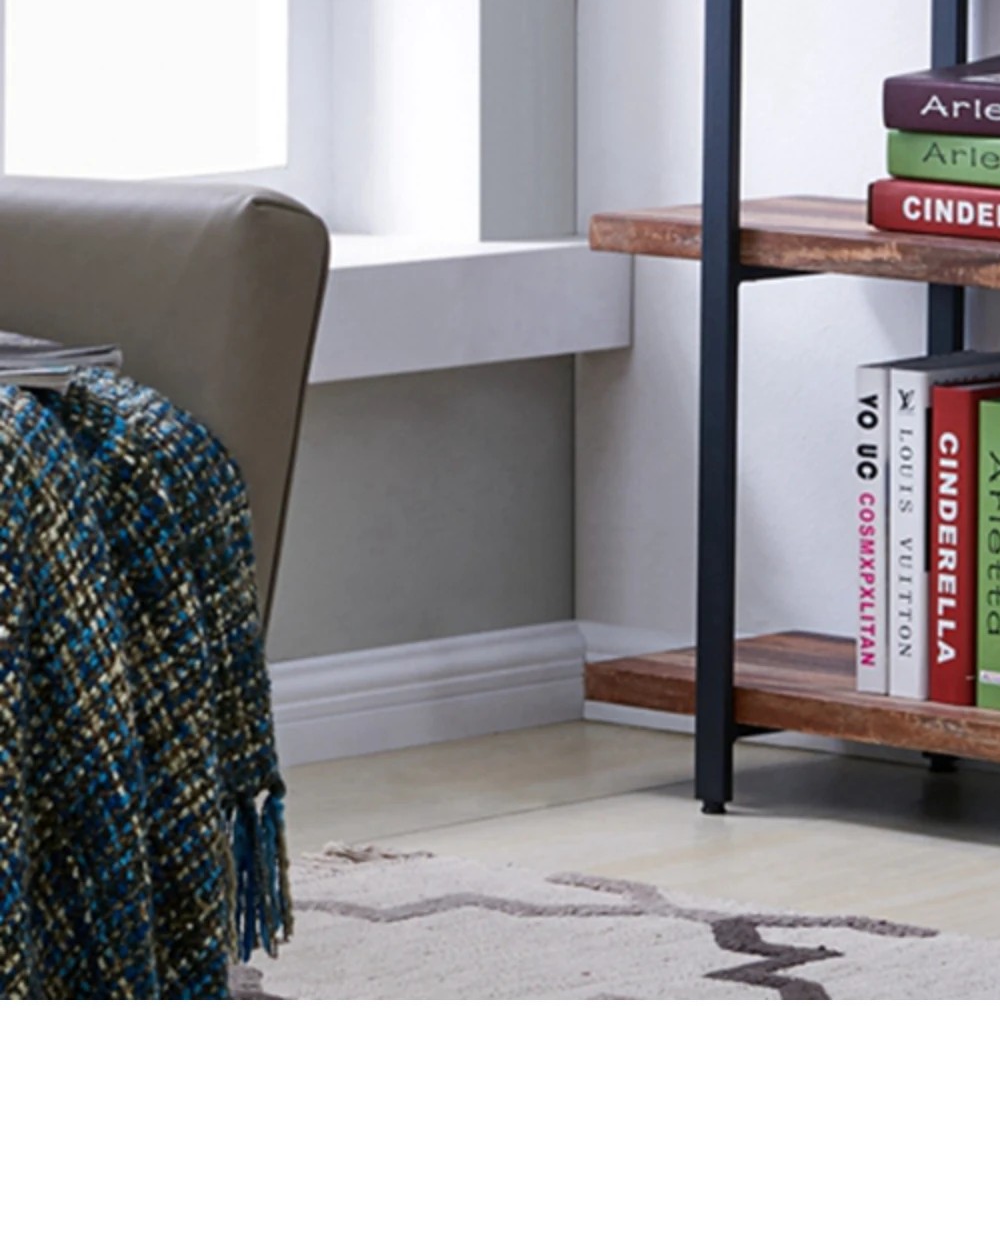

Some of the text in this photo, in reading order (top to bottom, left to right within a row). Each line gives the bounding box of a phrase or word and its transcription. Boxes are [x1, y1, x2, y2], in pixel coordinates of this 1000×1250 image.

[857, 394, 878, 667] YO UC COSMXPXLITAN
[899, 428, 914, 514] LOUIS
[937, 432, 960, 664] CINDERELLA
[898, 537, 914, 658] VUITTON
